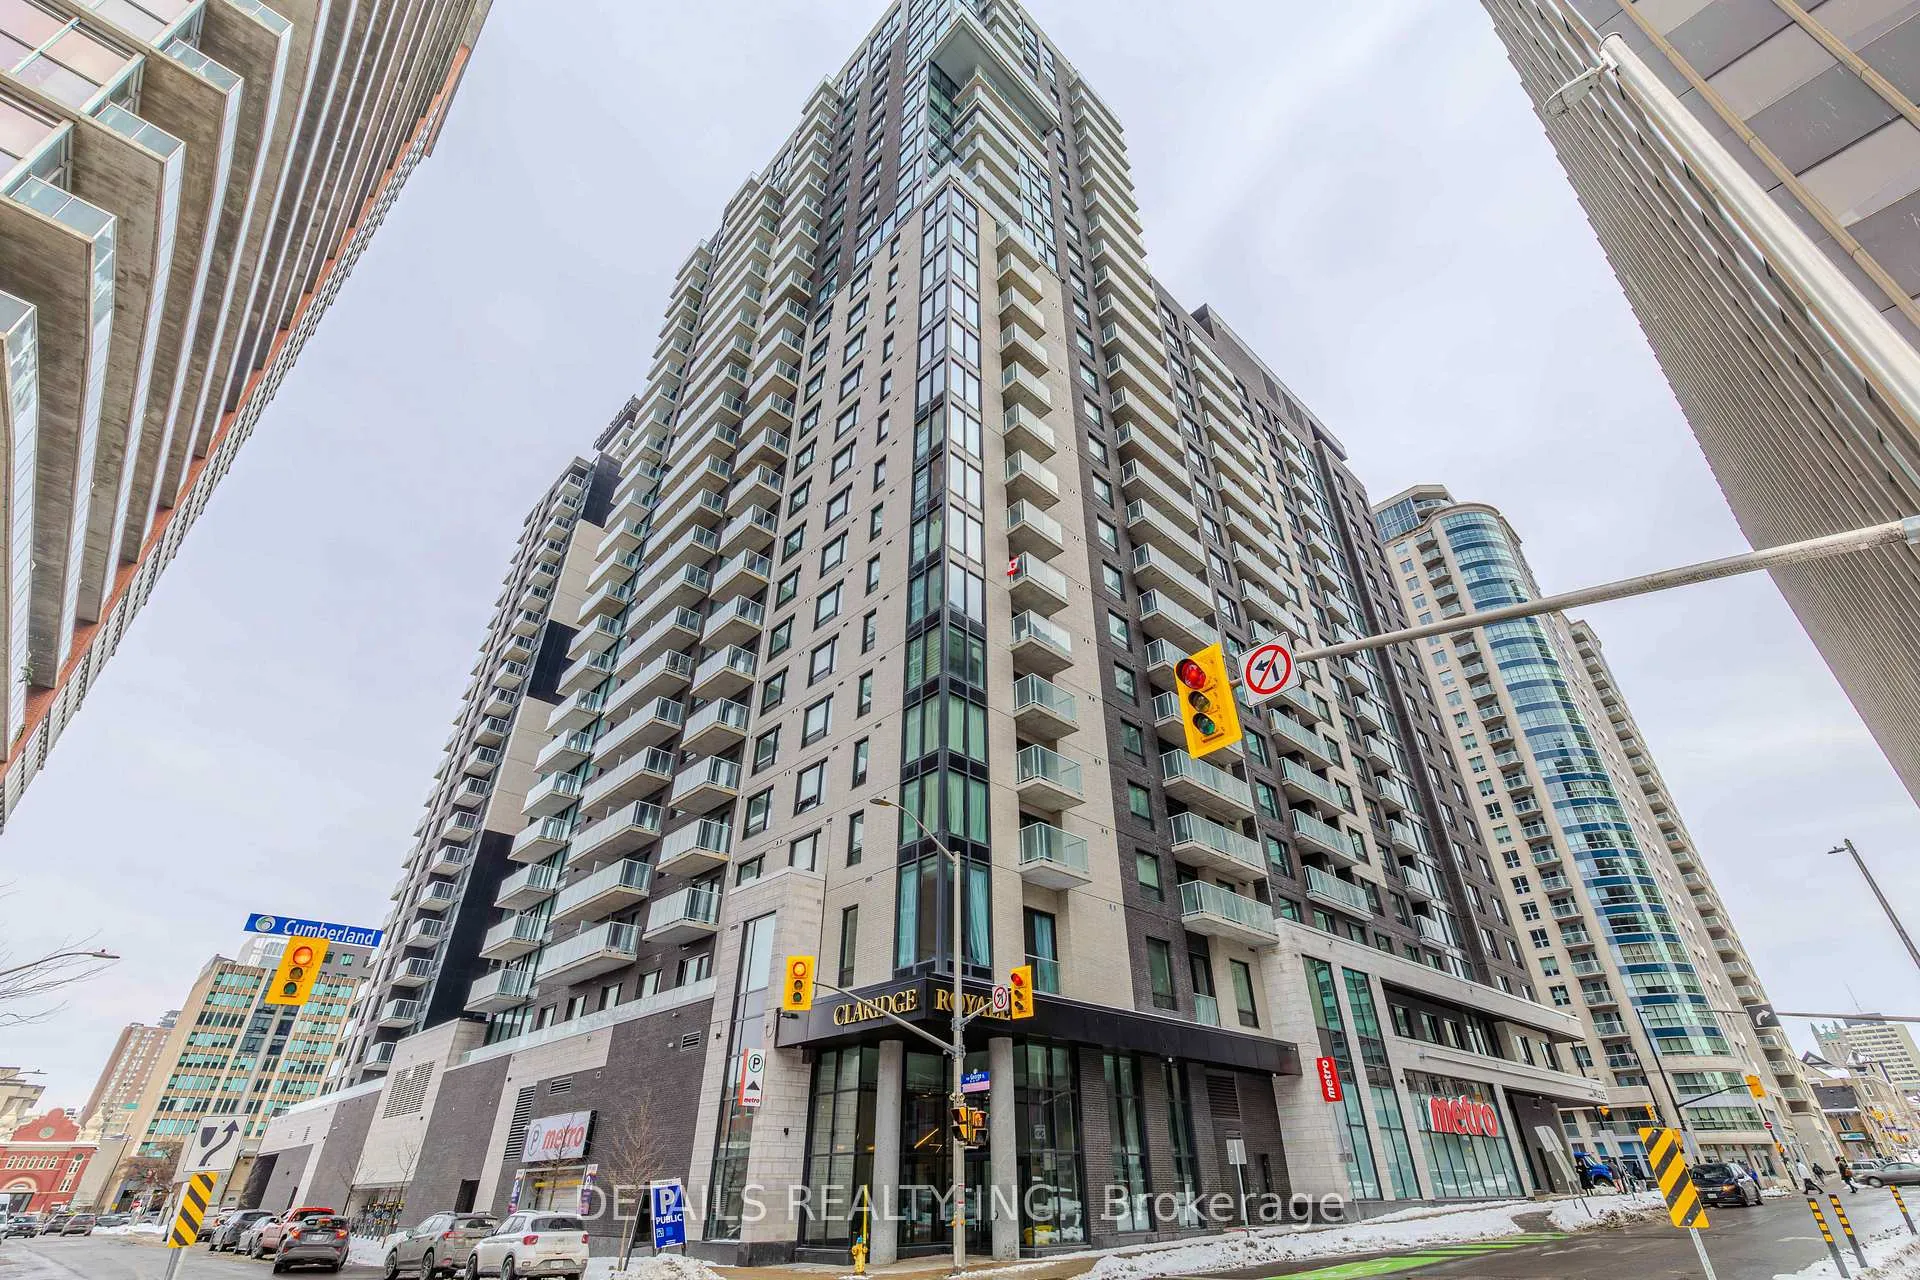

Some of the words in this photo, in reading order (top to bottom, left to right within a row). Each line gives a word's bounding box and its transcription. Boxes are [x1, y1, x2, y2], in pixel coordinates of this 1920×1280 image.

[283, 919, 377, 946] Cumberland
[833, 988, 918, 1026] CLARIDGE
[1321, 1060, 1336, 1099] metro
[1428, 1094, 1498, 1138] metro
[541, 1125, 585, 1150] metro
[659, 1189, 675, 1215] P
[655, 1213, 683, 1225] PUBLIC
